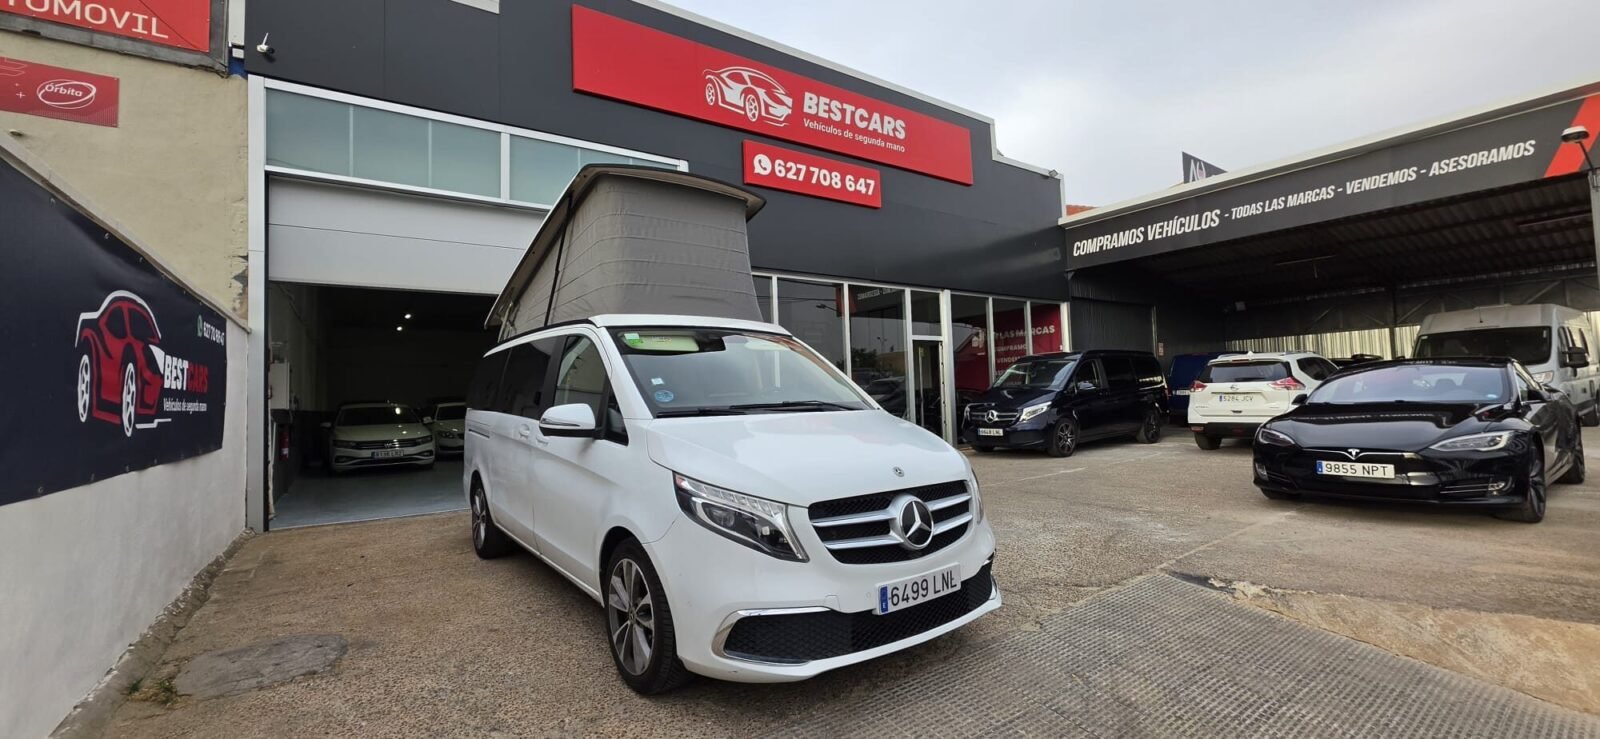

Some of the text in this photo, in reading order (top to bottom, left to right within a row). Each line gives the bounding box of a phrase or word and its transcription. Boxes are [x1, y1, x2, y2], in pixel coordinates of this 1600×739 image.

[45, 82, 83, 97] Órbita
[803, 91, 906, 140] BESTCARS
[803, 118, 906, 153] Vehículos de segunda mano
[774, 159, 875, 196] 627 708 647
[1073, 226, 1145, 257] COMPRAMOS
[1147, 208, 1221, 241] VEHÍCULOS
[1230, 201, 1265, 221] TODAS
[1264, 196, 1286, 213] LAS
[1286, 185, 1335, 208] MARCAS
[1345, 166, 1418, 195] VENDEMOS
[1428, 139, 1537, 177] ASESORAMOS
[1015, 325, 1056, 337] MRCAS
[1325, 462, 1388, 476] 9855 NPT
[890, 569, 957, 607] 6499 LNL
